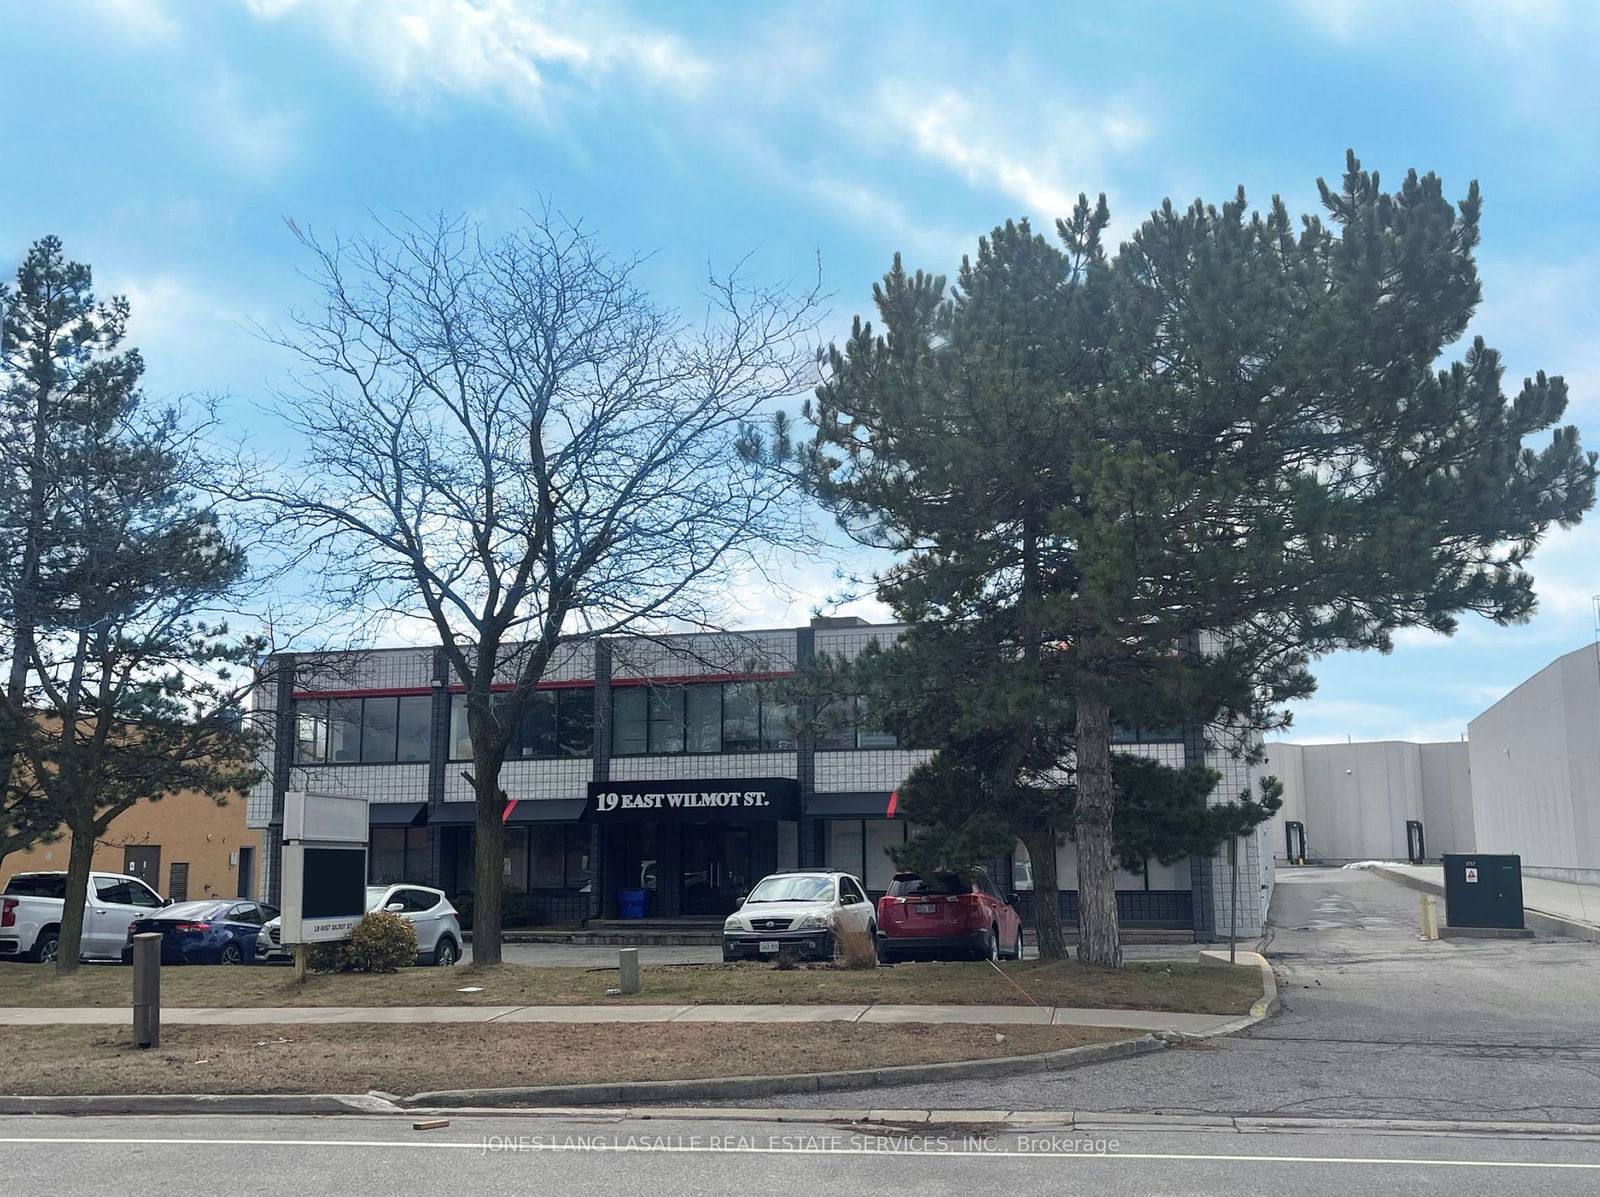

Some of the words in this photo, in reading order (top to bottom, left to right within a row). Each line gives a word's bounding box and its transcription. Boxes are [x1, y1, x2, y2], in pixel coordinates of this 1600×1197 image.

[596, 793, 619, 811] 19
[621, 794, 664, 809] EAST
[666, 792, 741, 808] WILMOT
[743, 791, 770, 806] ST.
